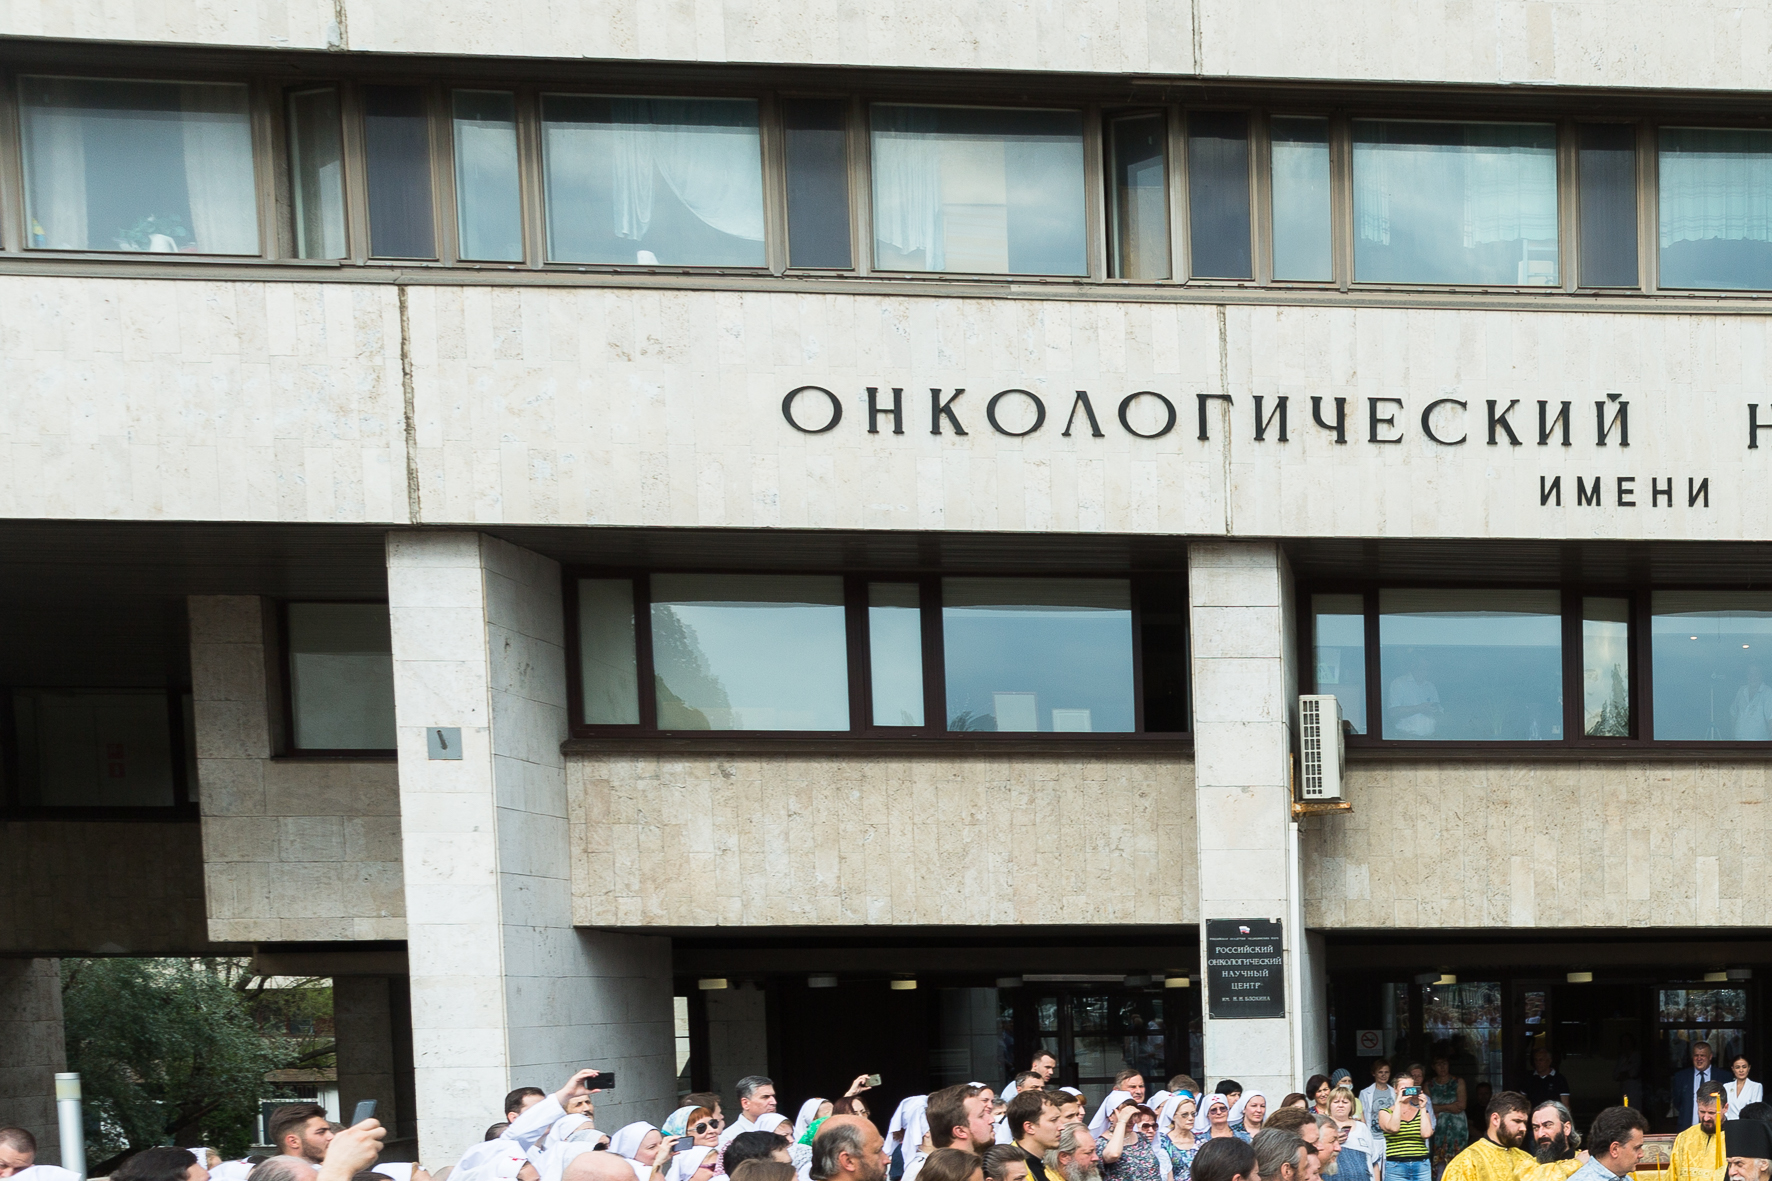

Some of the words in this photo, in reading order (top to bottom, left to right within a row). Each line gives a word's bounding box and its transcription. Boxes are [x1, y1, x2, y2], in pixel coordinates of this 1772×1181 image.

[781, 385, 1631, 448] ОНКОЛОГИЧЕСКИЙ
[1540, 475, 1710, 509] ИМЕНИ
[1215, 945, 1274, 954] РОССИЙСКИЙ
[1208, 957, 1282, 966] ОНКОЛОГИЧЕСКИЙ
[1222, 969, 1269, 978] НАУЧНЫЙ
[1231, 982, 1261, 991] ЦЕНТР
